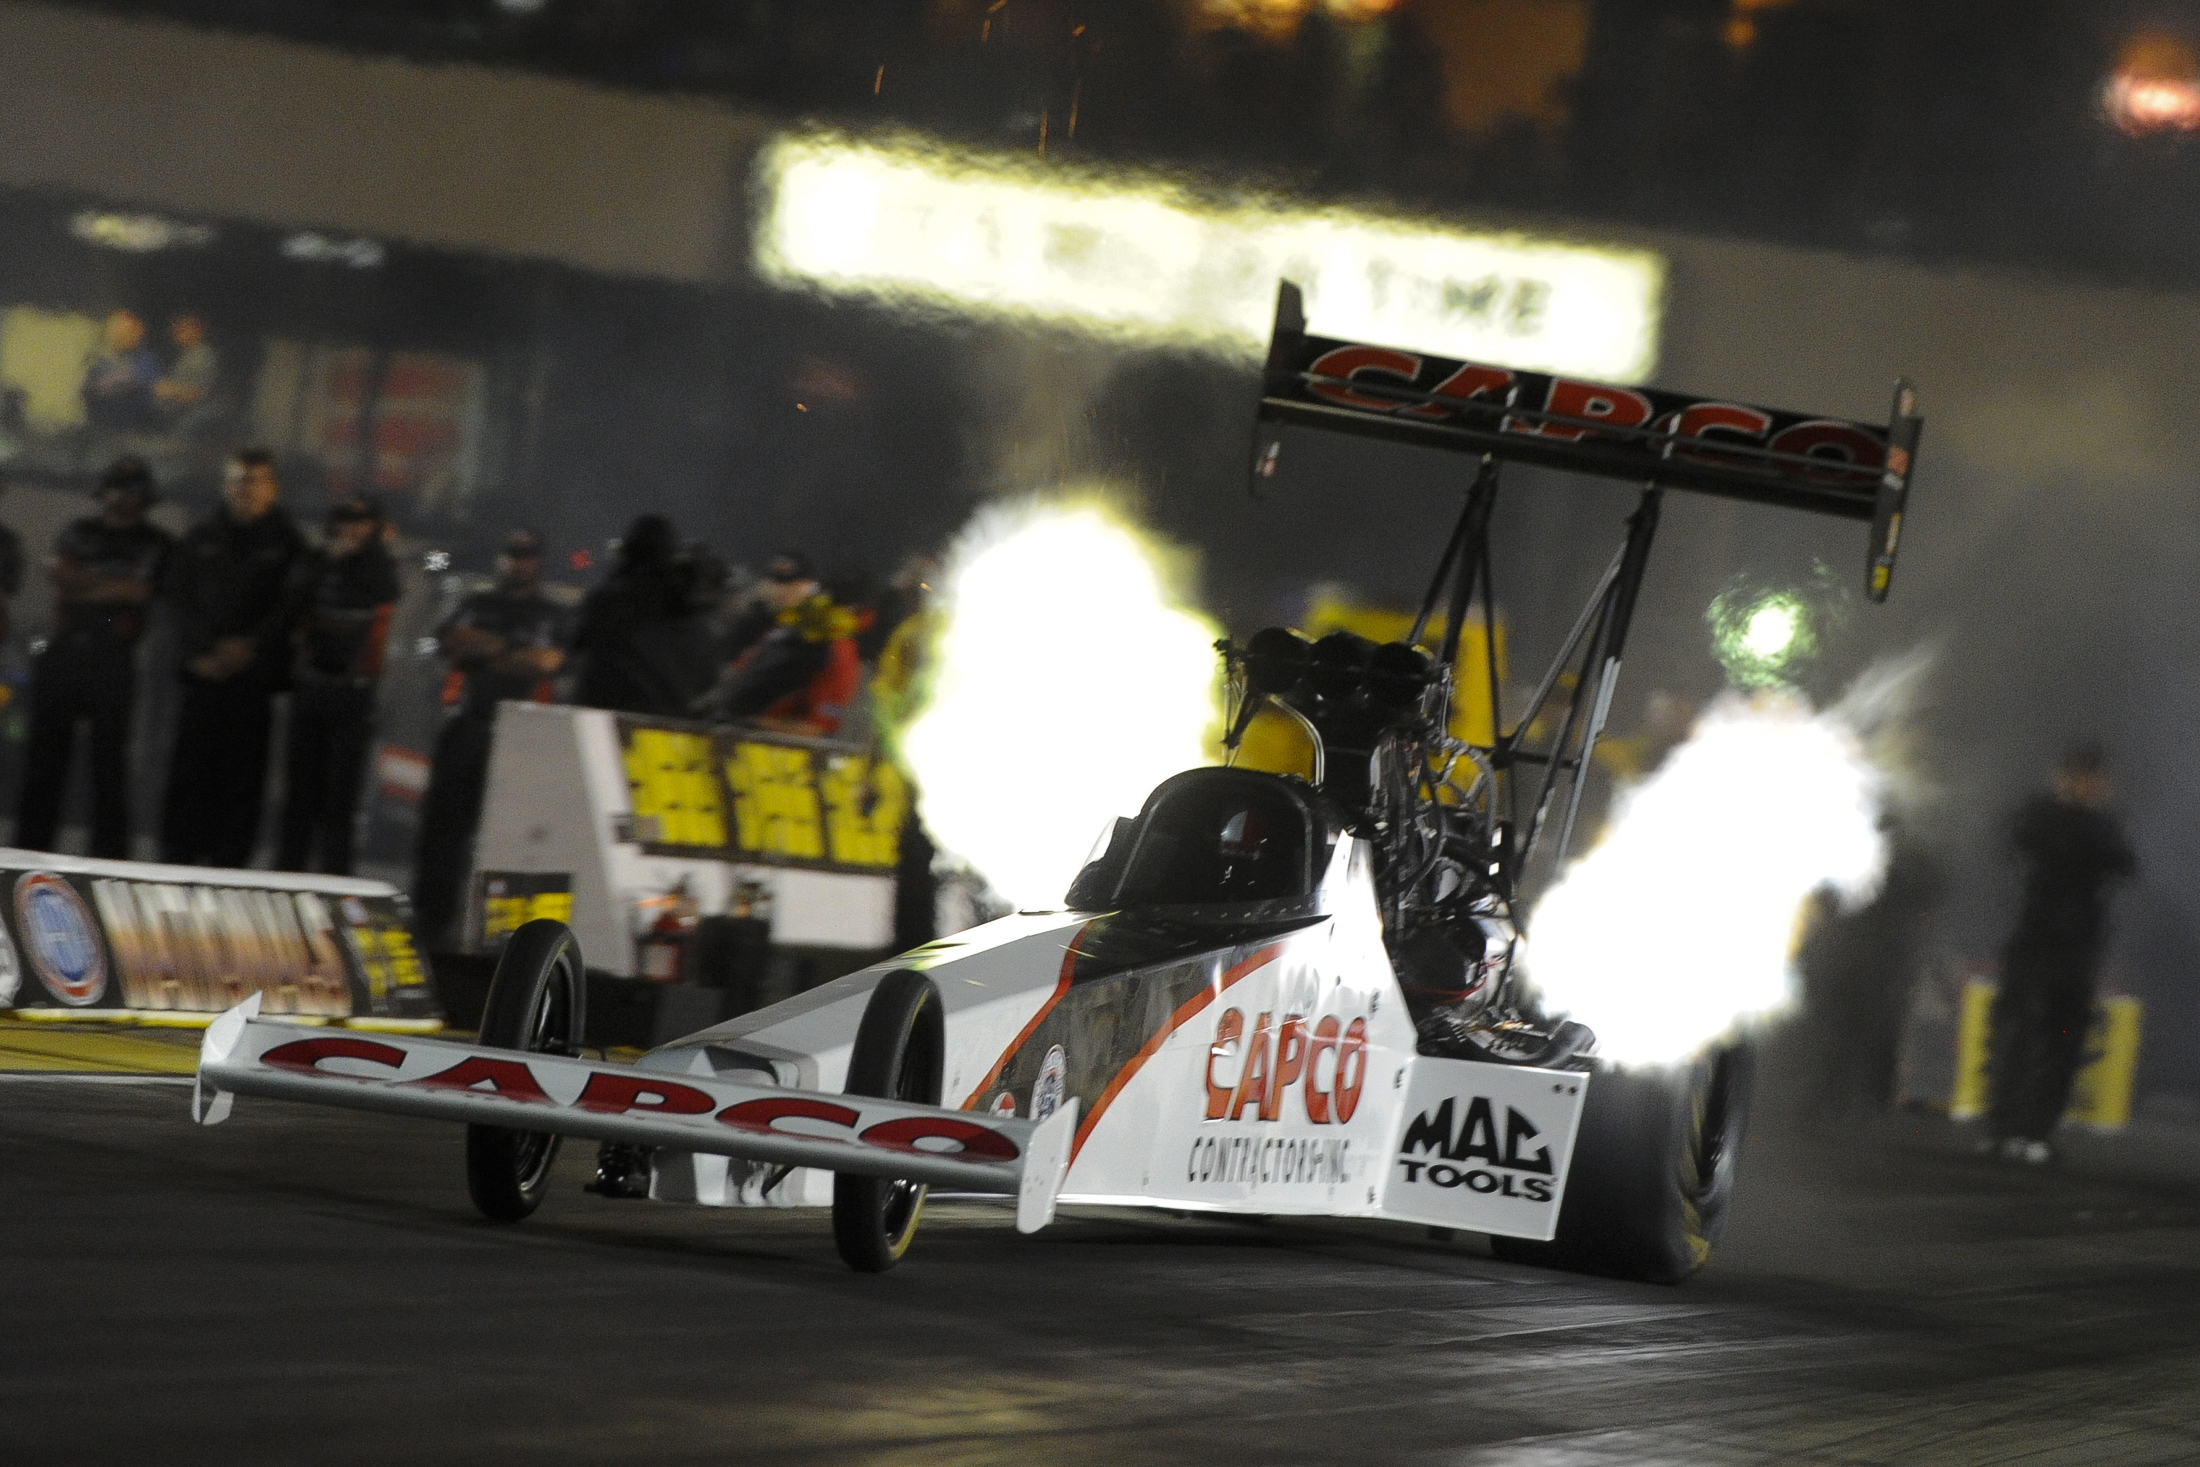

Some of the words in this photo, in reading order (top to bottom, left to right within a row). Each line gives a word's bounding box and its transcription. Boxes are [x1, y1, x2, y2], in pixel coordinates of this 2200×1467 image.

[1305, 343, 1888, 482] CAPCO
[259, 1037, 1020, 1162] CAPCO
[1206, 1007, 1368, 1125] CAPCO
[1398, 1160, 1555, 1203] TOOLS
[1399, 1096, 1554, 1176] MAC
